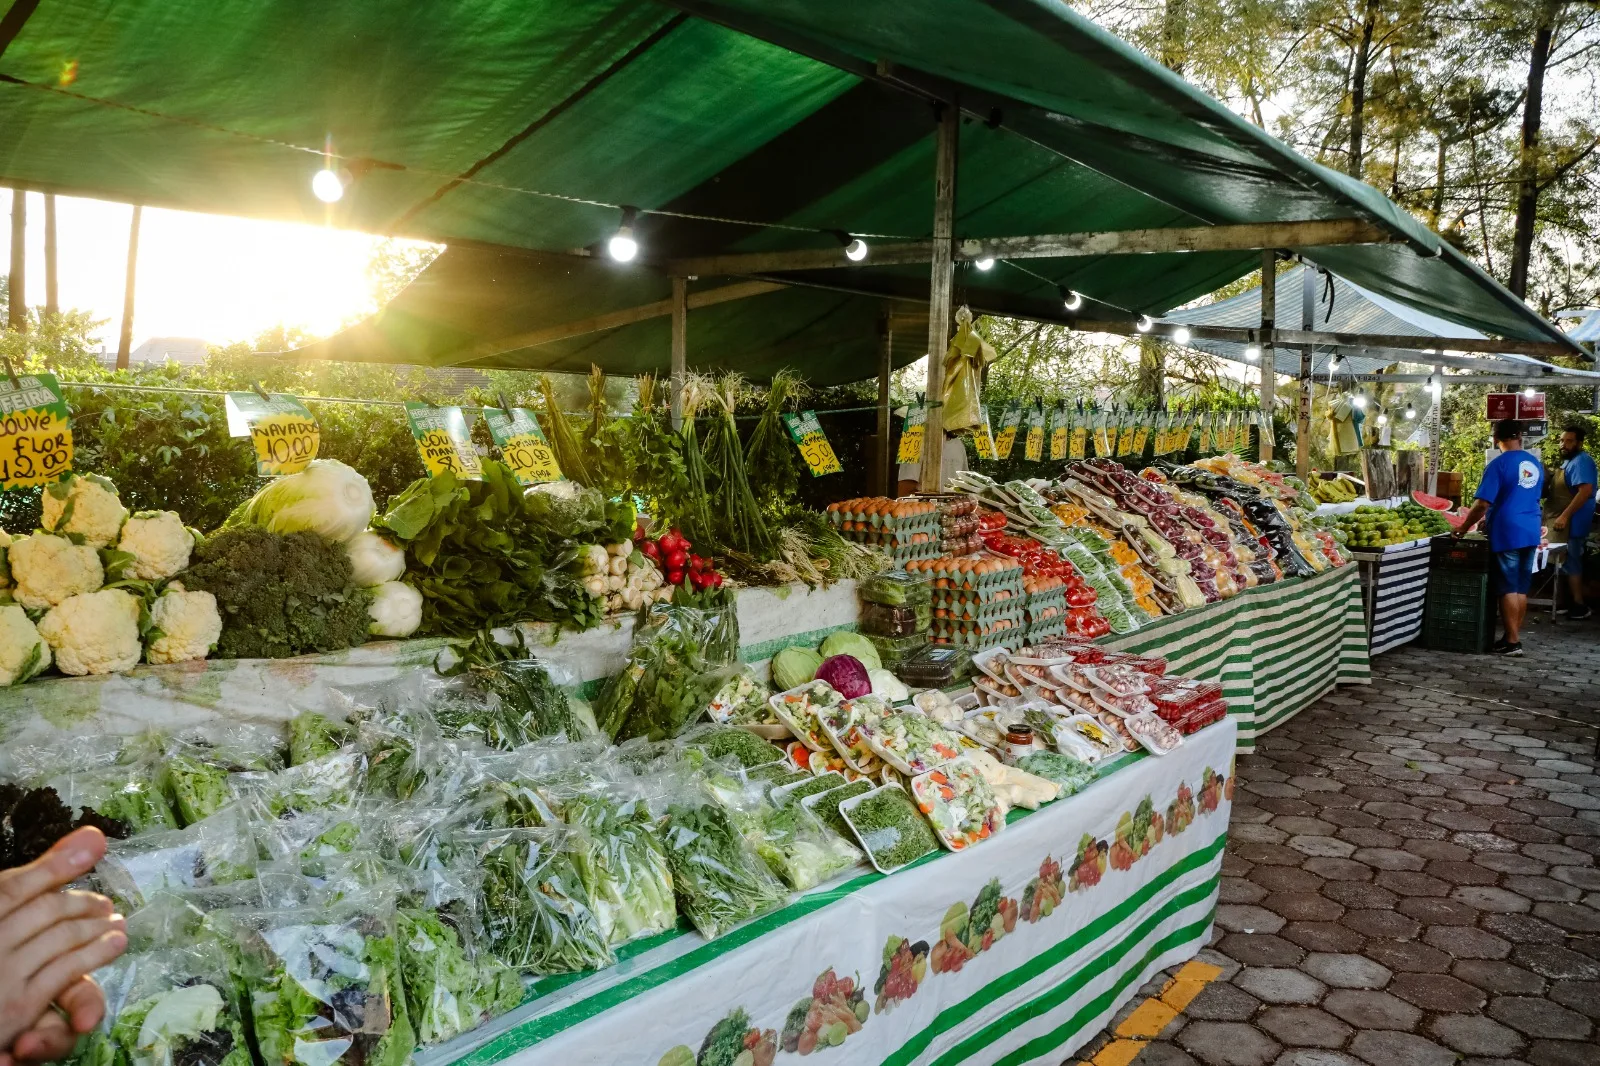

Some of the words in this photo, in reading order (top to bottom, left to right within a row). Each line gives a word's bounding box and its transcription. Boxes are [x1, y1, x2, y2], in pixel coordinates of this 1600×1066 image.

[20, 377, 41, 389] DIA
[0, 388, 58, 413] FEIRA
[506, 419, 538, 436] FEIRA
